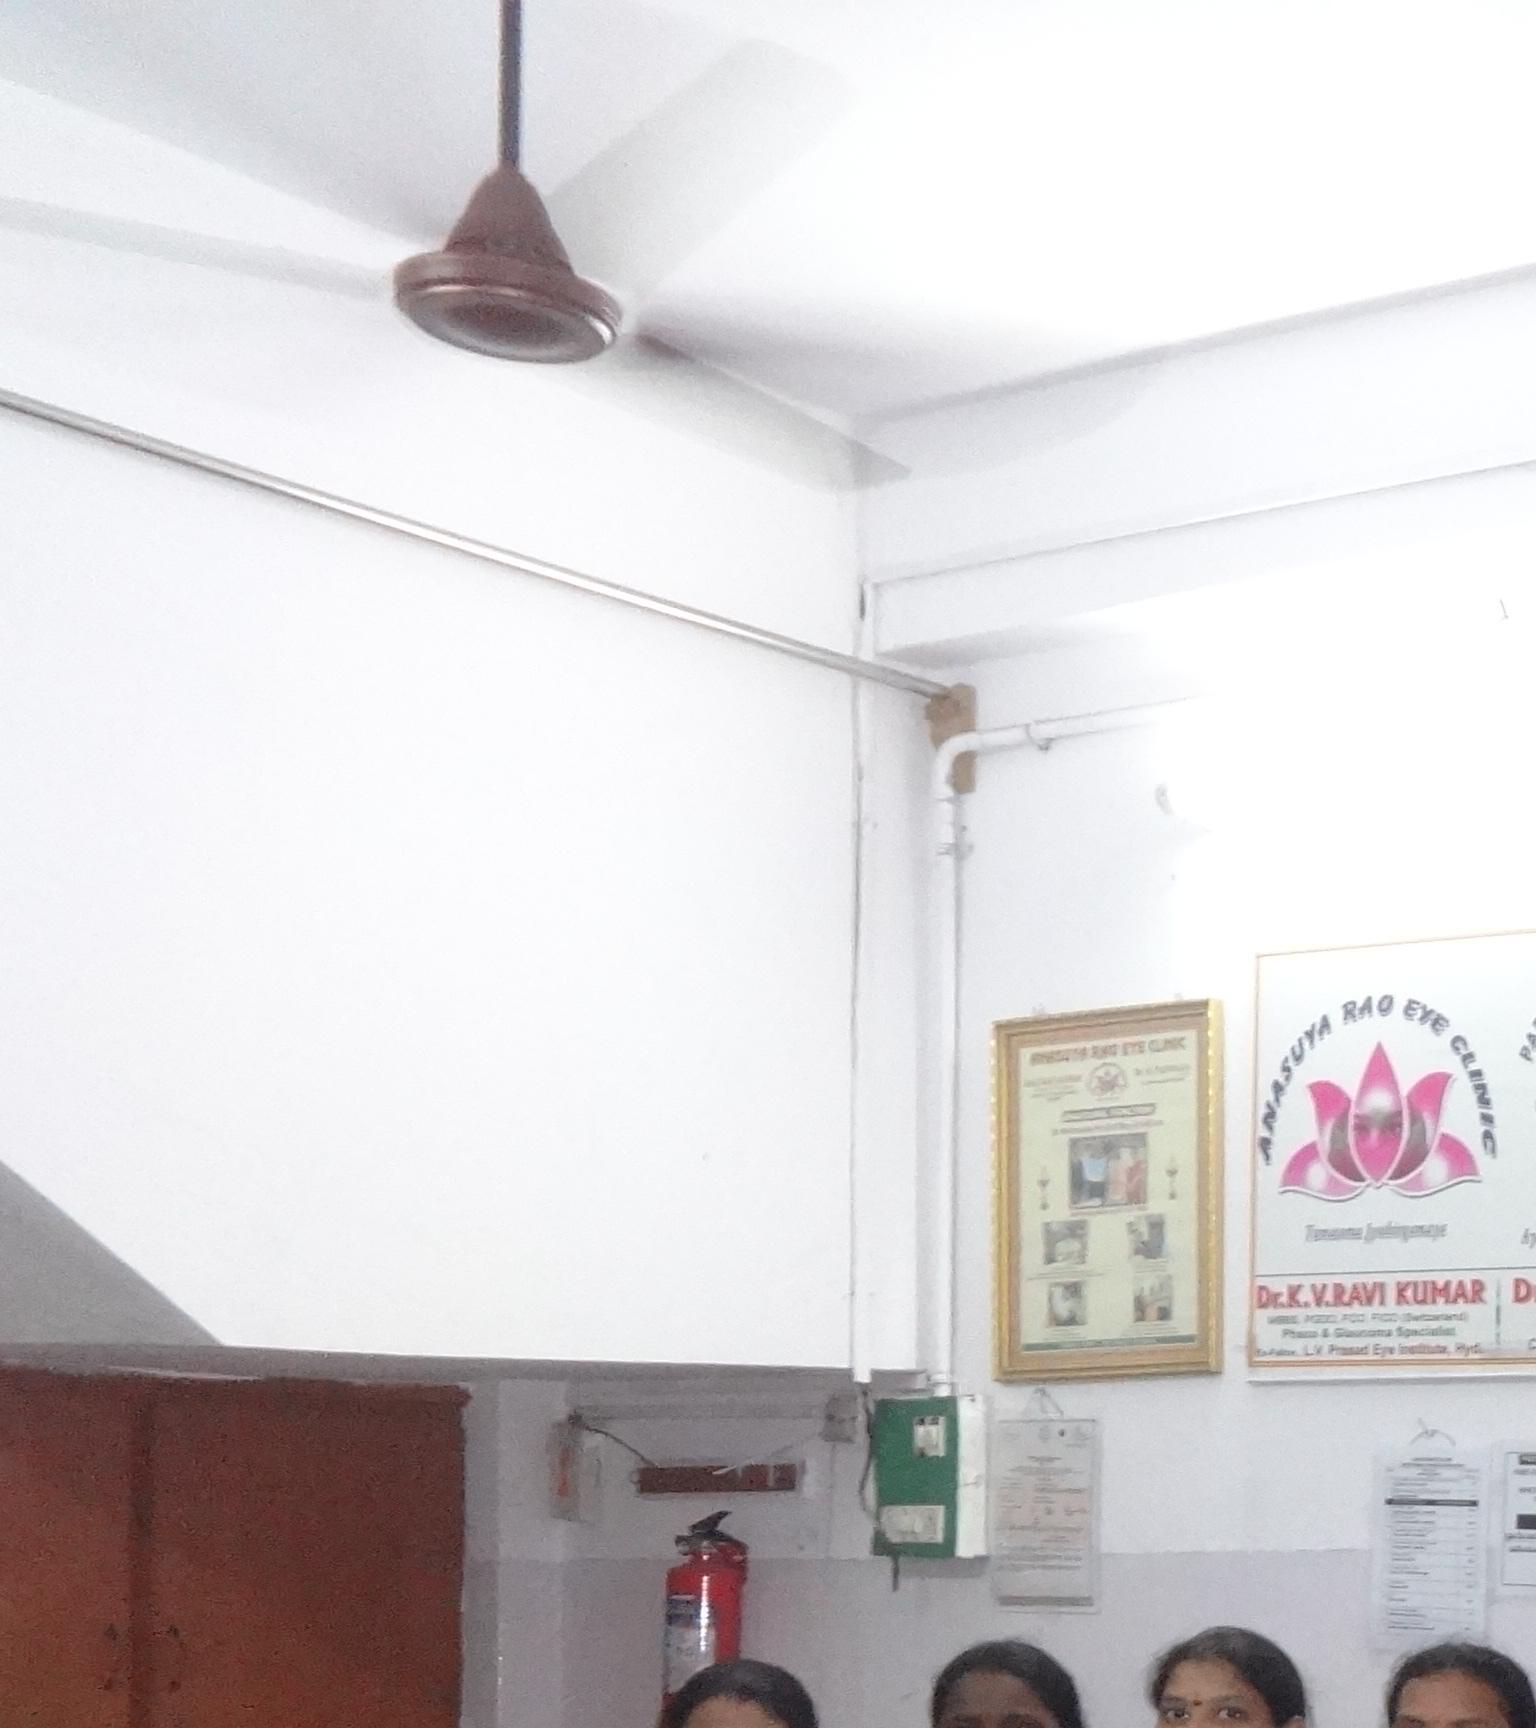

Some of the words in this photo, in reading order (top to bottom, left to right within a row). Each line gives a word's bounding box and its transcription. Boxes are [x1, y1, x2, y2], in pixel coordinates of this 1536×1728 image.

[1259, 1014, 1332, 1166] ANASUYA
[1342, 994, 1394, 1026] RAO
[1403, 998, 1450, 1036] EYE
[1450, 1035, 1497, 1159] CLINIC
[1394, 1278, 1488, 1305] KUMAR
